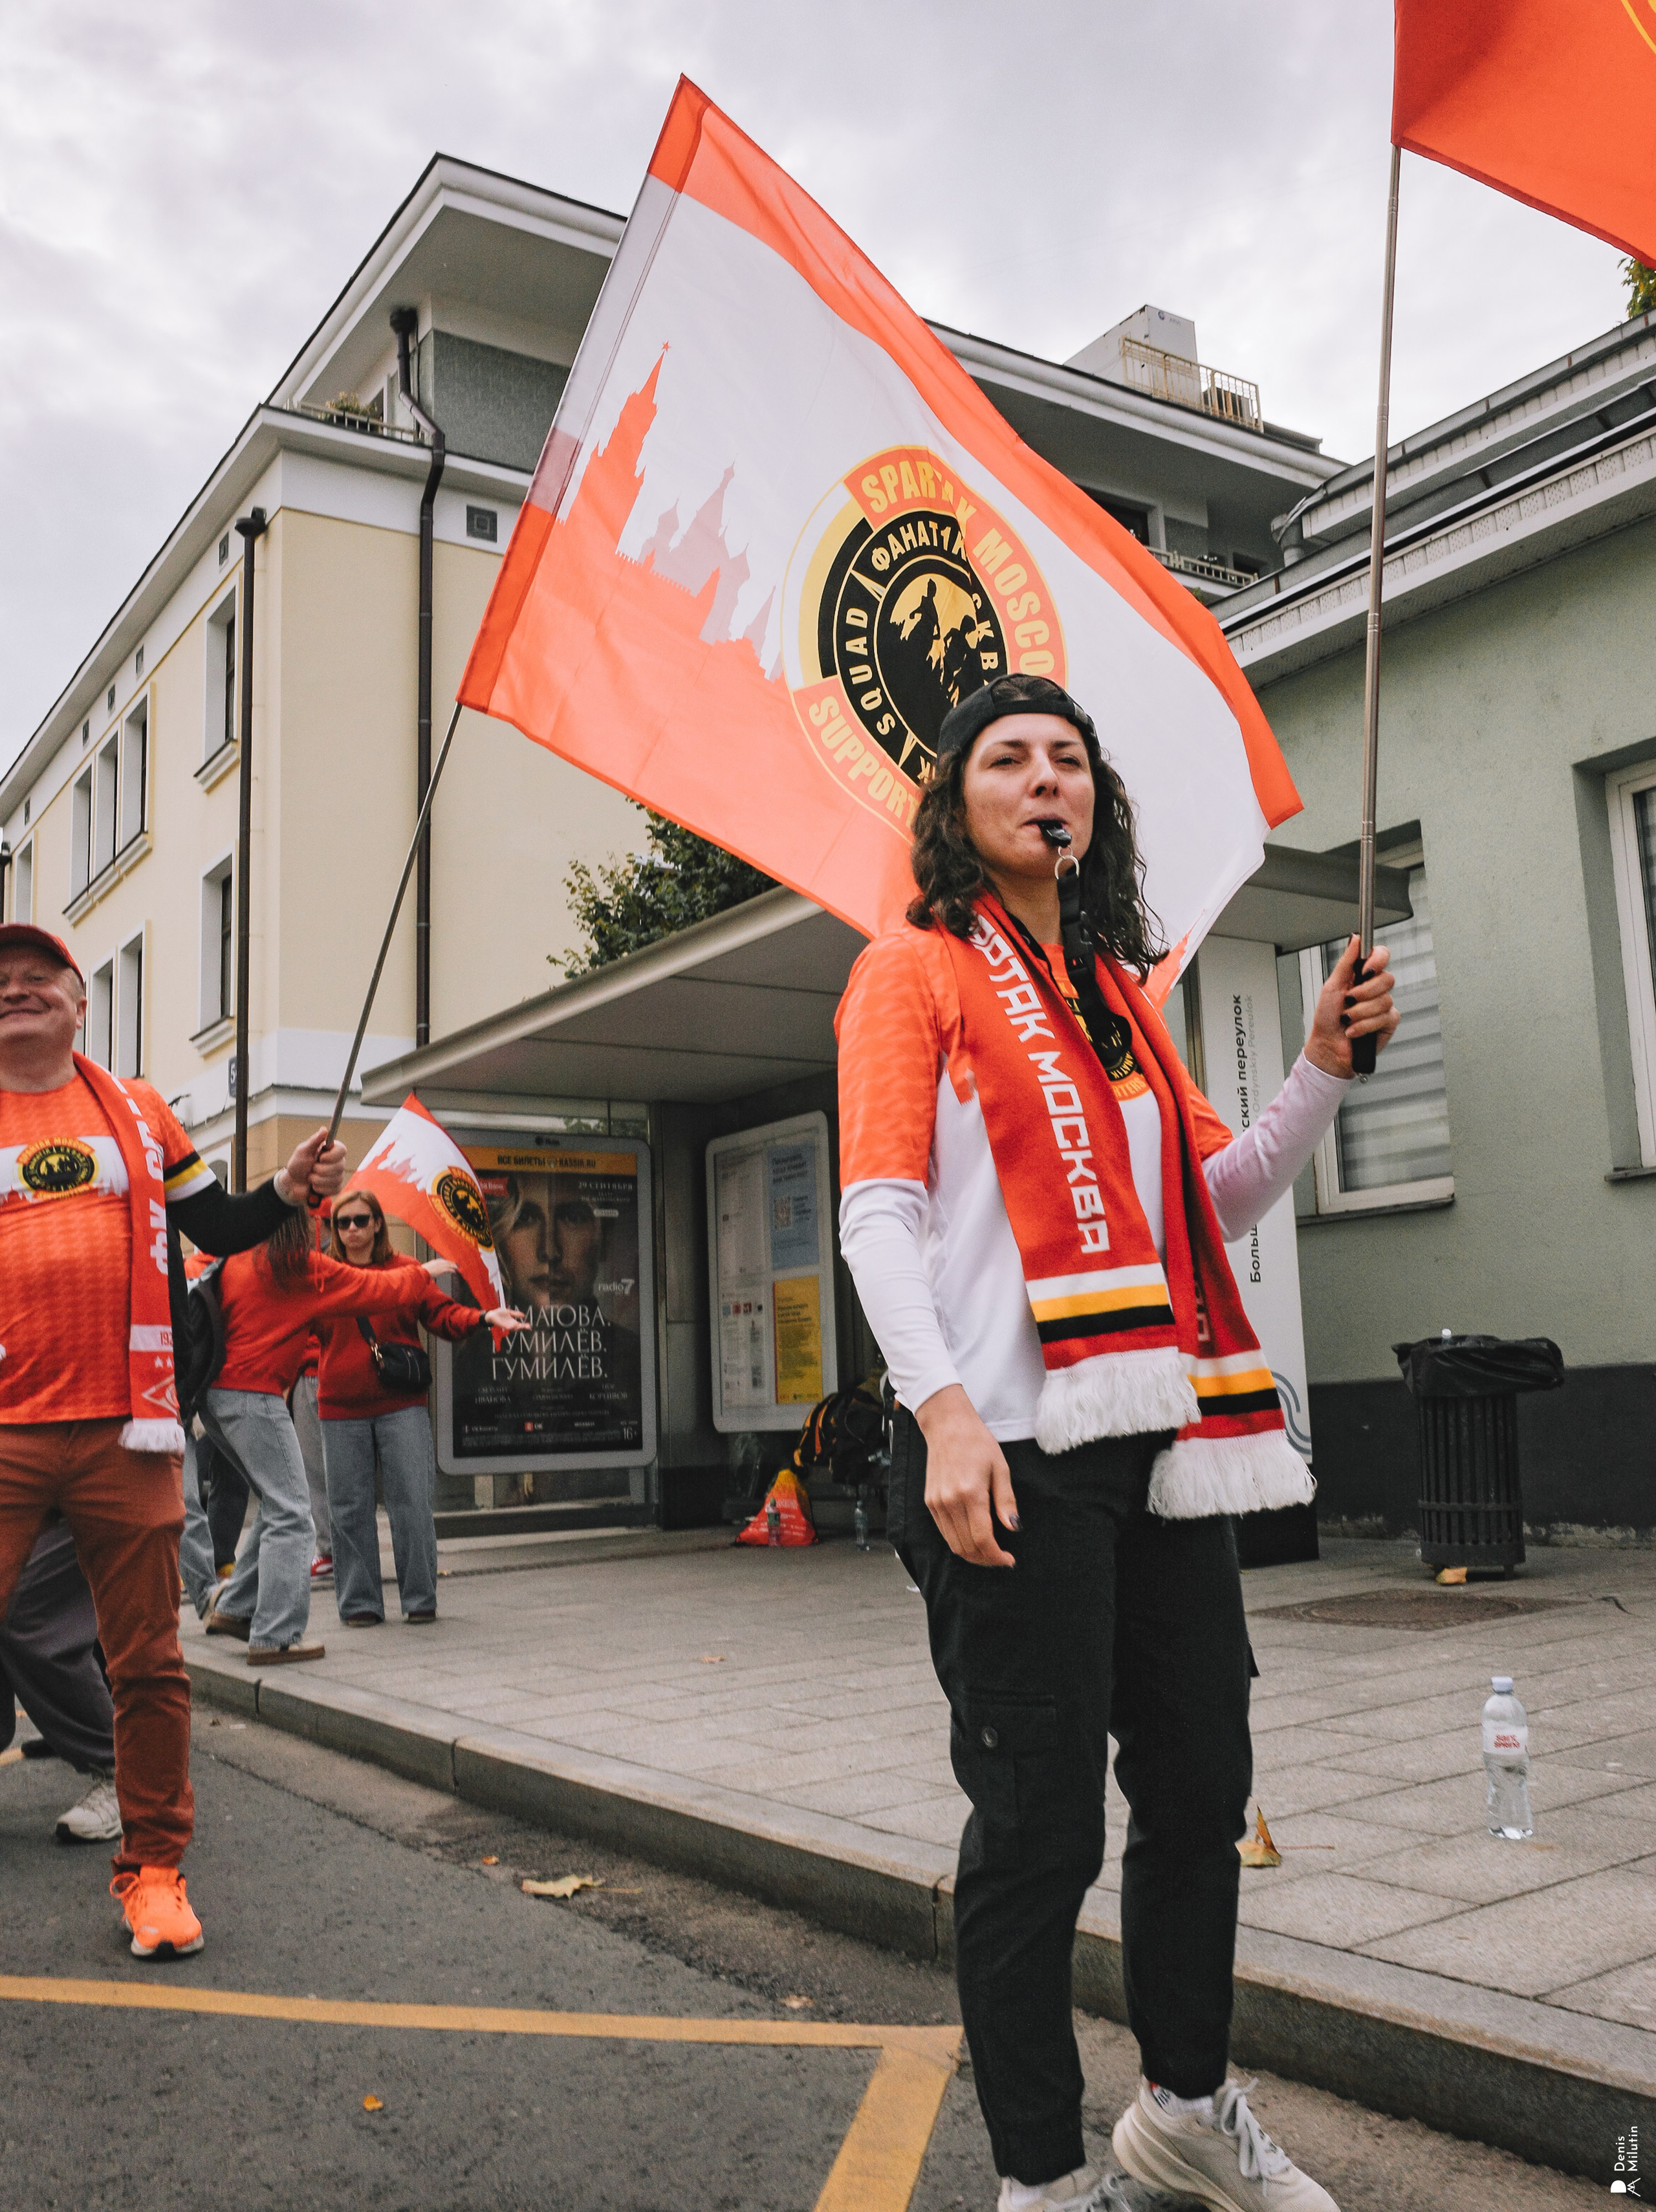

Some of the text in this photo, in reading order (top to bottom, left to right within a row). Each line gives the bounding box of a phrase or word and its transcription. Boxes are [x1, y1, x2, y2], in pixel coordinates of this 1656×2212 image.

[972, 527, 1055, 675] MOSCO
[845, 607, 896, 735] SQUAD
[809, 695, 922, 828] SUPPORT
[230, 1062, 237, 1084] 5
[1233, 994, 1247, 1080] переулок
[969, 914, 1110, 1254] АРТАК МОСКВА
[1250, 1224, 1261, 1282] Больш
[508, 1304, 611, 1327] МАТОВА.
[492, 1353, 608, 1381] ГУМИЛЁВ.
